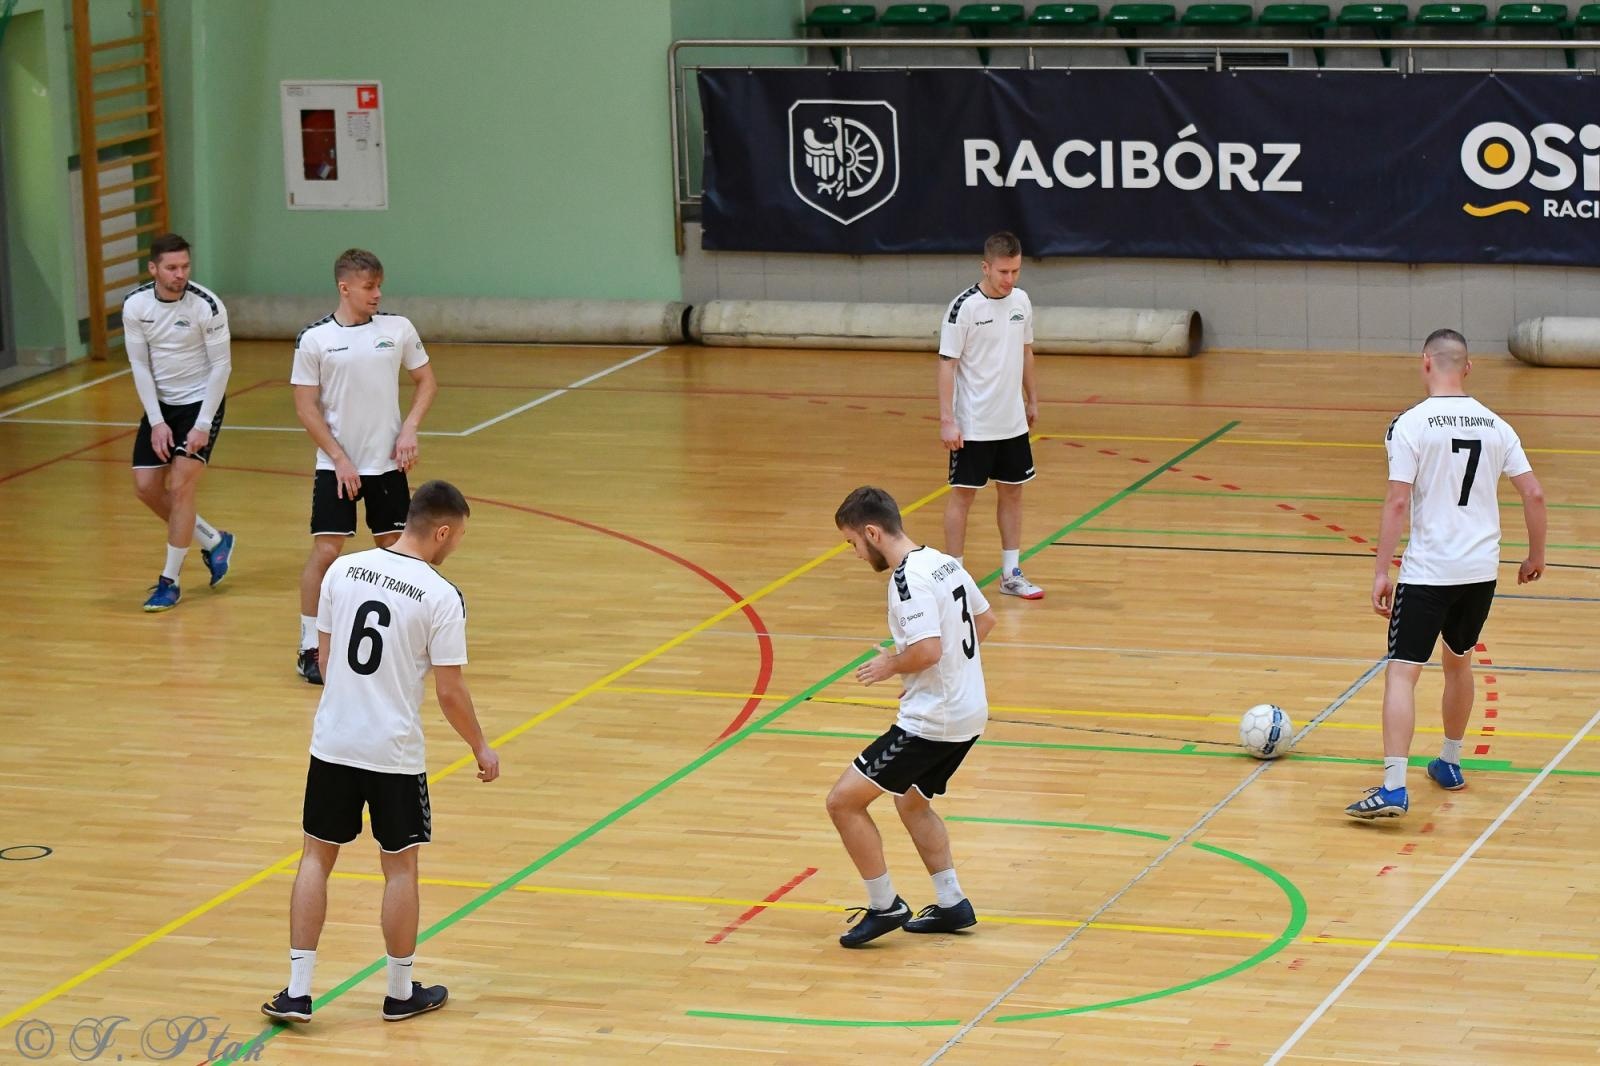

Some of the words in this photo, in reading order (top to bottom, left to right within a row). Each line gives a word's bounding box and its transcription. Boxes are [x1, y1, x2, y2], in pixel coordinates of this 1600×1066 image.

[963, 123, 1302, 193] RACIBÓRZ
[1427, 415, 1457, 428] PIĘKNY
[1459, 416, 1496, 429] TRAWNIK
[1451, 438, 1482, 507] 7
[345, 566, 382, 586] PIĘKNY
[381, 575, 426, 602] TRAWNIK
[347, 600, 391, 675] 6
[952, 584, 975, 660] 3
